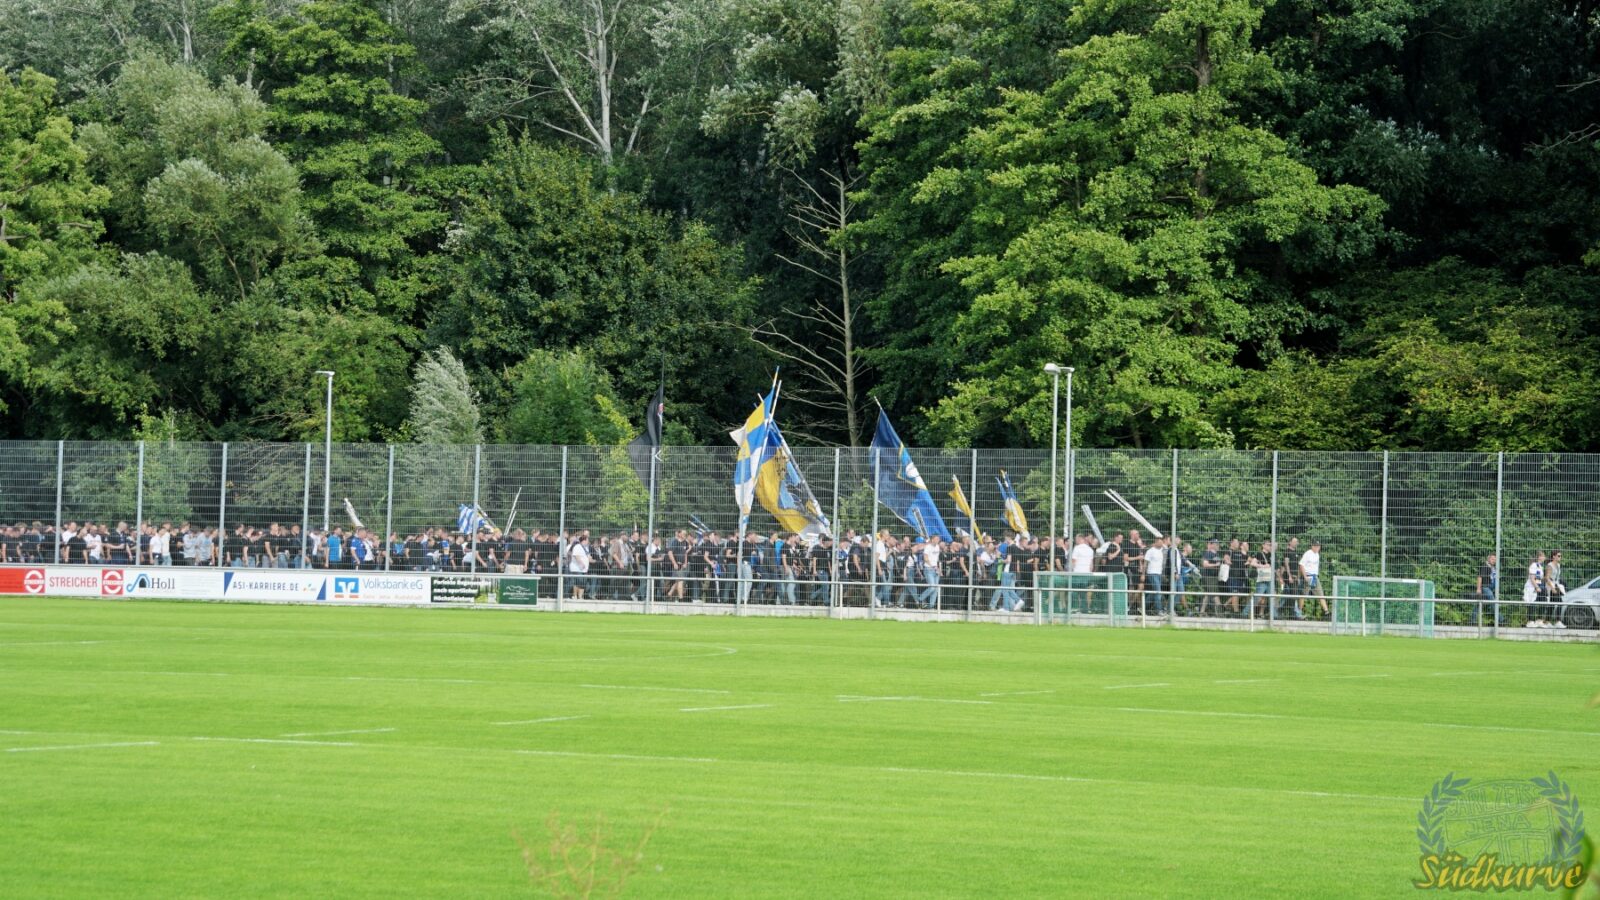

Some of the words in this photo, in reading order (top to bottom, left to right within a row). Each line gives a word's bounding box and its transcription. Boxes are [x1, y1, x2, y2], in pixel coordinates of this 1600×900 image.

[49, 576, 98, 587] STREICHER
[151, 577, 175, 589] Holl
[233, 581, 299, 592] ASI-KARRIERE.DE
[363, 578, 408, 589] Volksbank
[409, 579, 423, 590] eG
